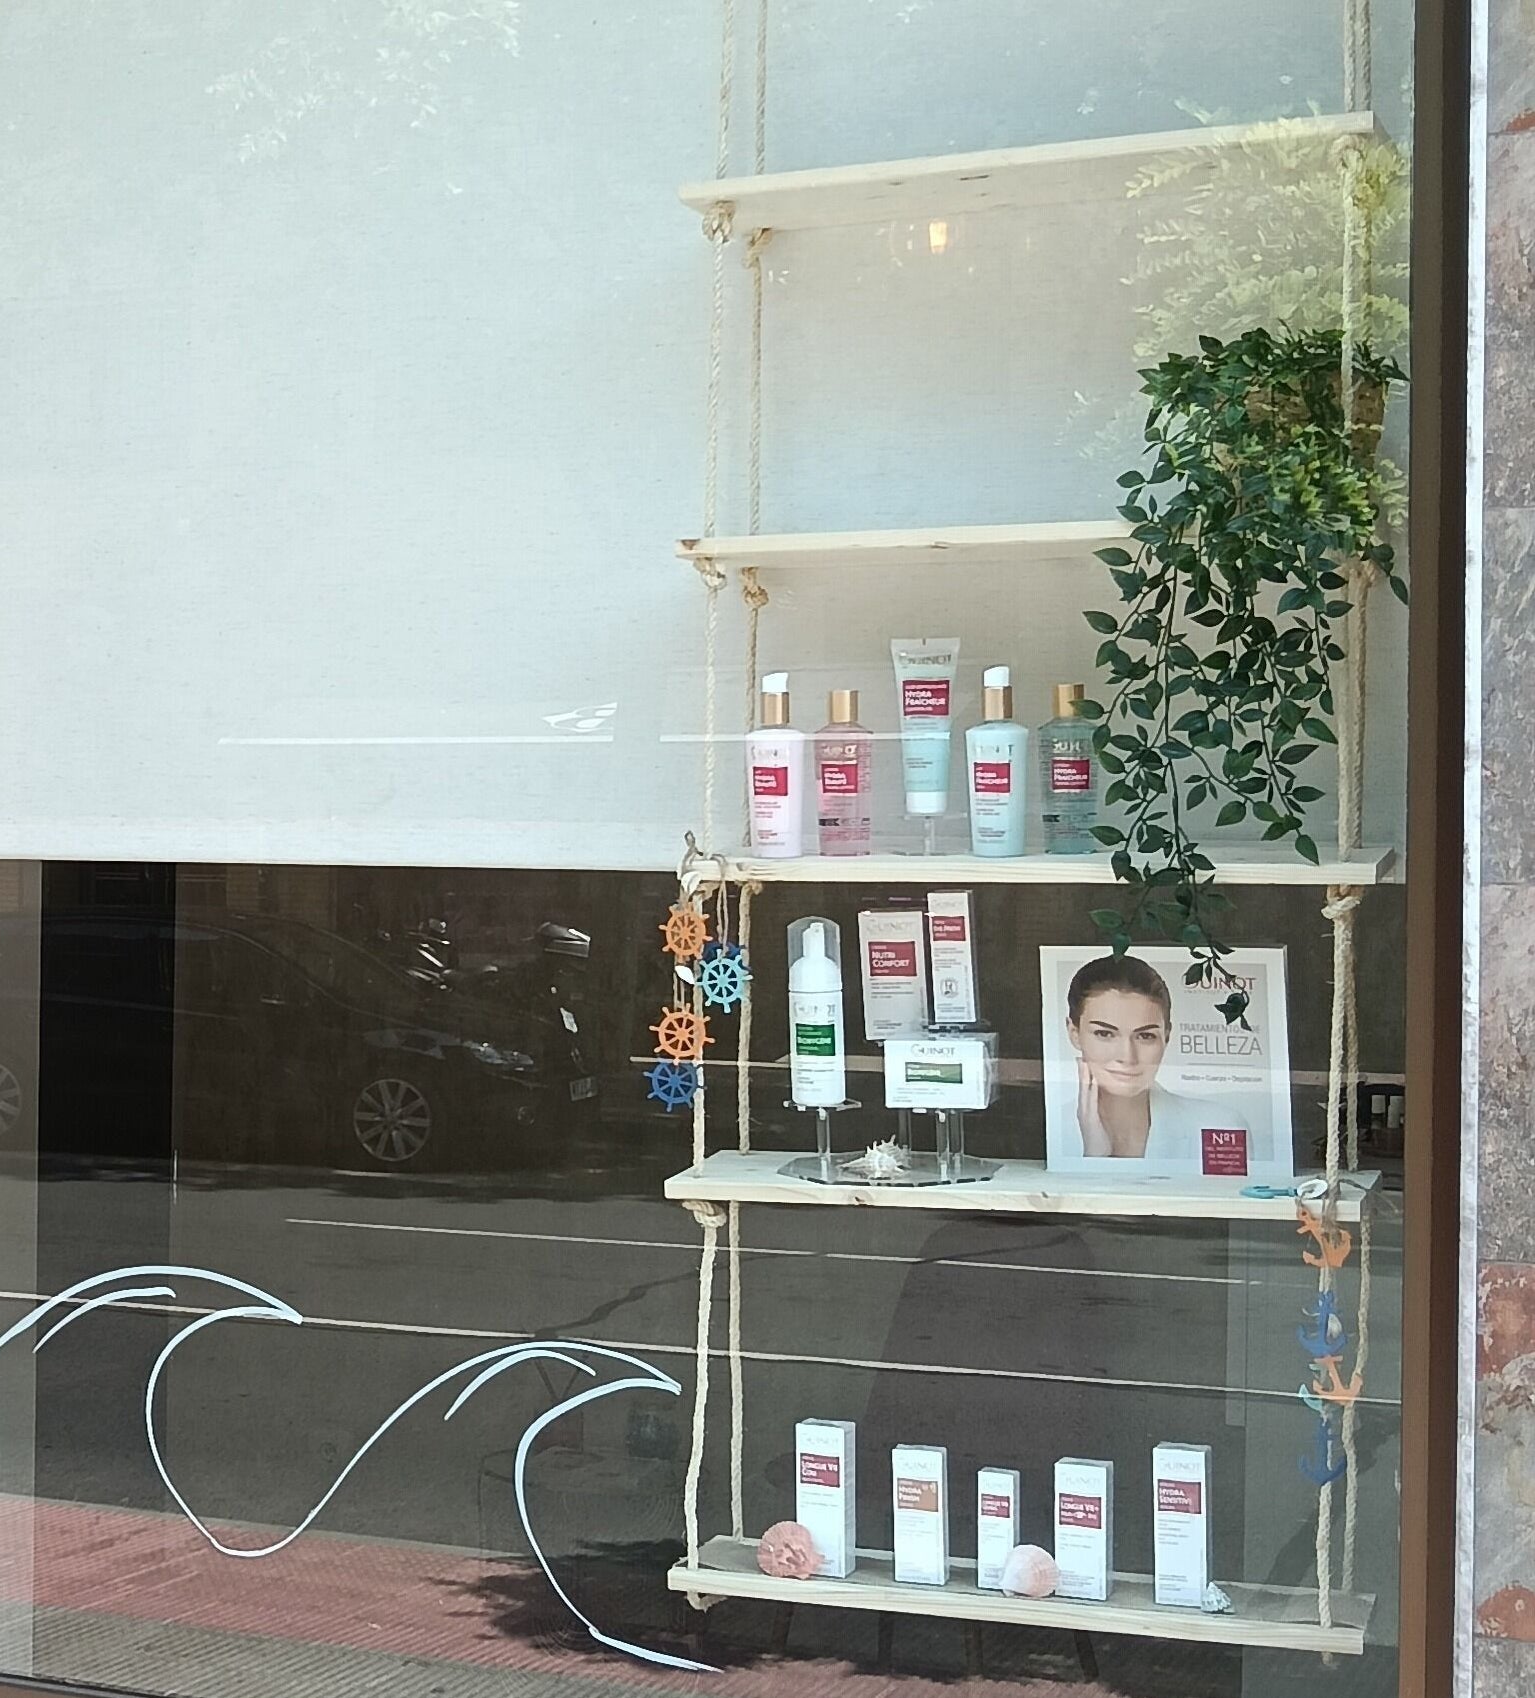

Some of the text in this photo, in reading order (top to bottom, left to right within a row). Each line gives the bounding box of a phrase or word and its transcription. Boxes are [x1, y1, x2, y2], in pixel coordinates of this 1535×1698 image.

[910, 1043, 956, 1057] GUINOT
[1180, 1035, 1263, 1056] BELLEZA
[1158, 1487, 1185, 1497] HYDRA
